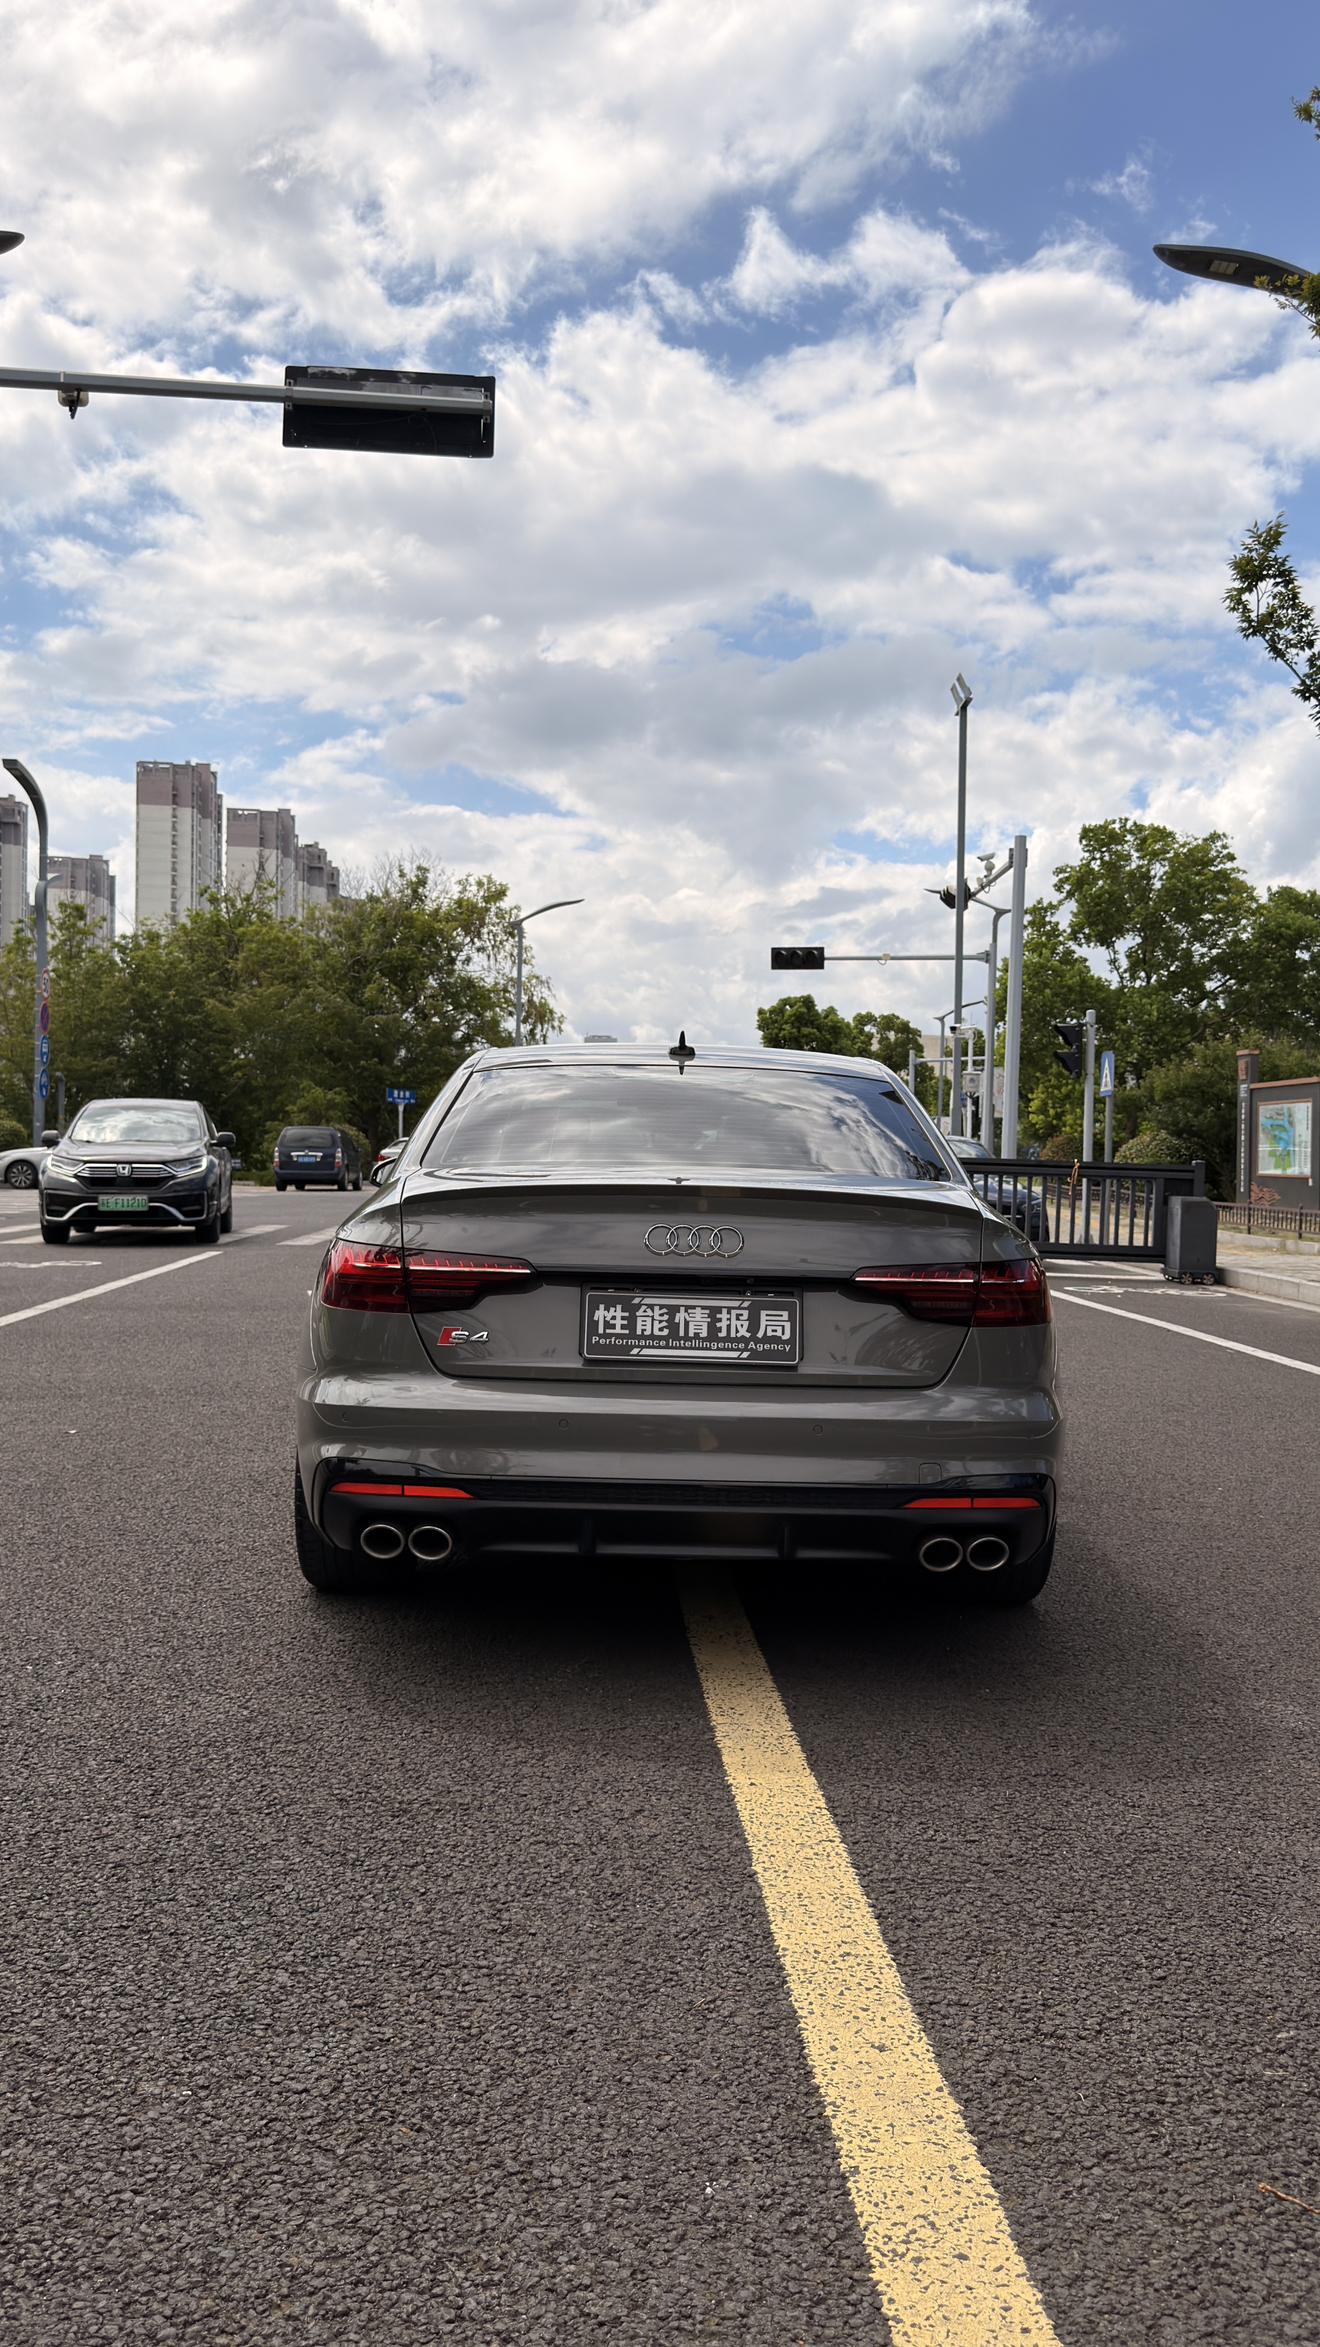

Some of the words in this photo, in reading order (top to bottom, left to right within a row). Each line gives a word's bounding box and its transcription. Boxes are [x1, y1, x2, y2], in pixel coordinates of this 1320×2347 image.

[593, 1304, 792, 1341] 性能情报局
[448, 1330, 489, 1344] S4
[592, 1336, 666, 1347] Performance
[668, 1339, 745, 1350] Intellingence
[747, 1341, 791, 1352] Agency
